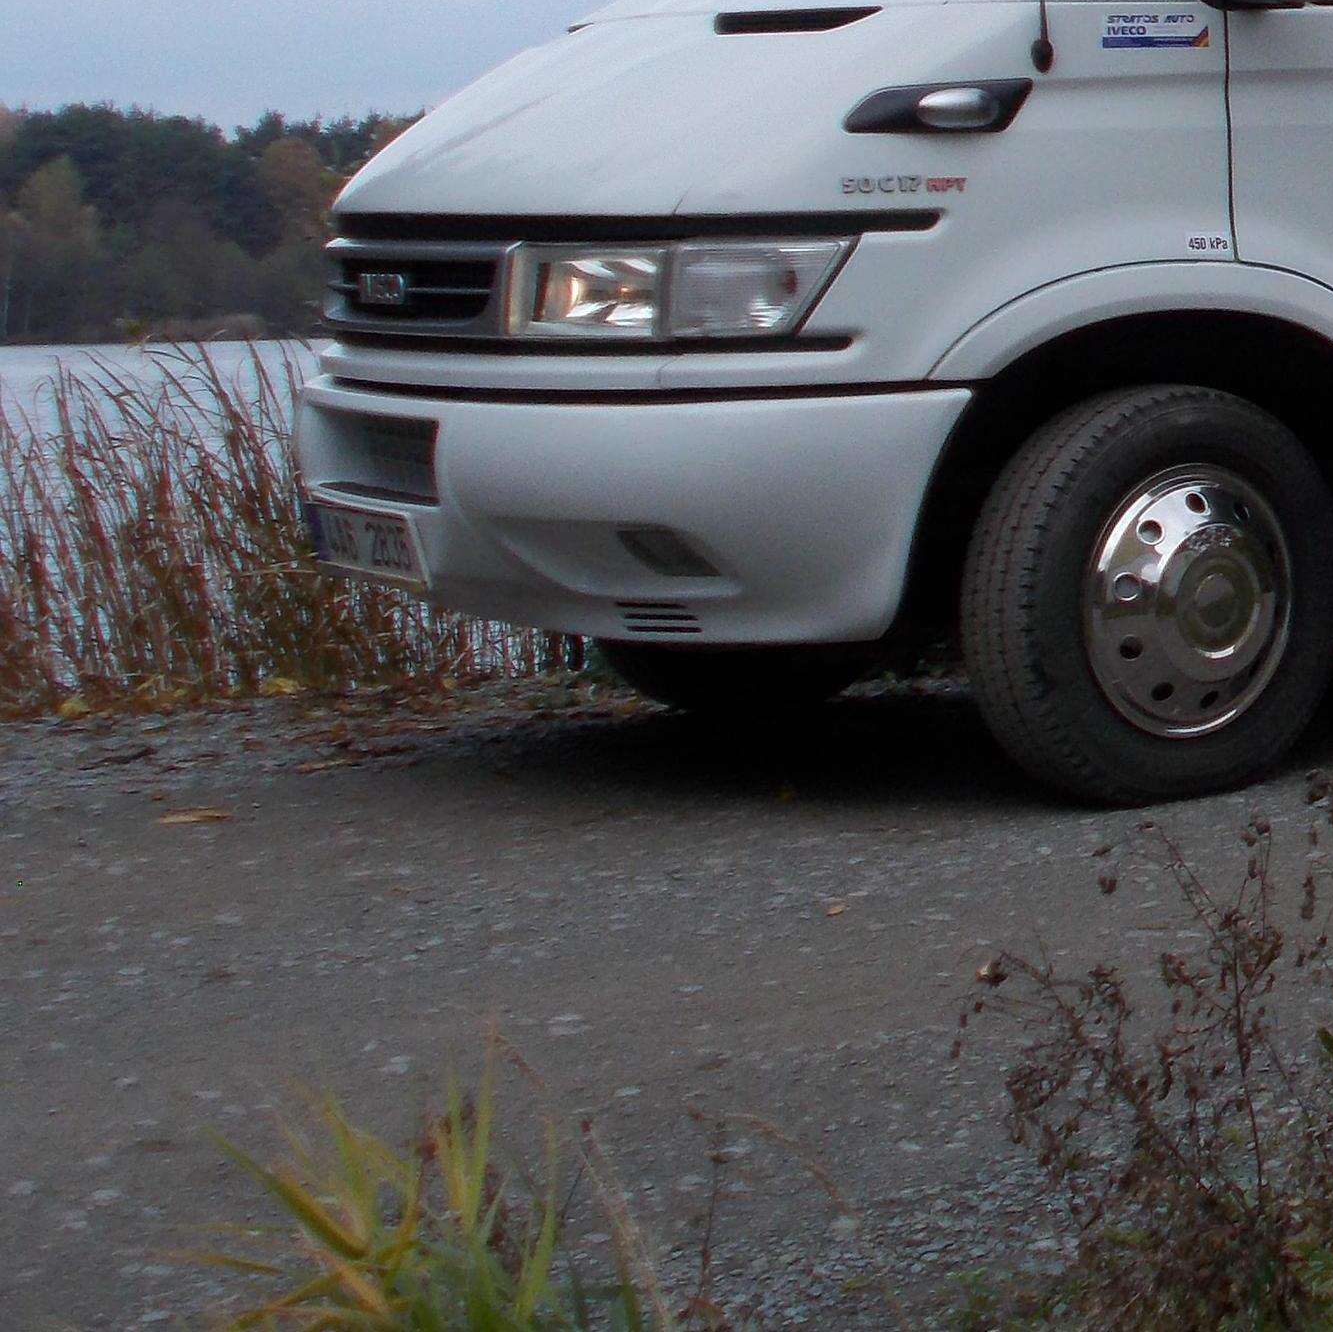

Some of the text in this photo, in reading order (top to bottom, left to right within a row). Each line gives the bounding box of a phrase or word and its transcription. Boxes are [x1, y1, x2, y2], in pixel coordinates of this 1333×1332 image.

[1163, 14, 1195, 24] AUTO
[1106, 26, 1147, 36] IVECO
[1188, 237, 1229, 250] 450 kPa
